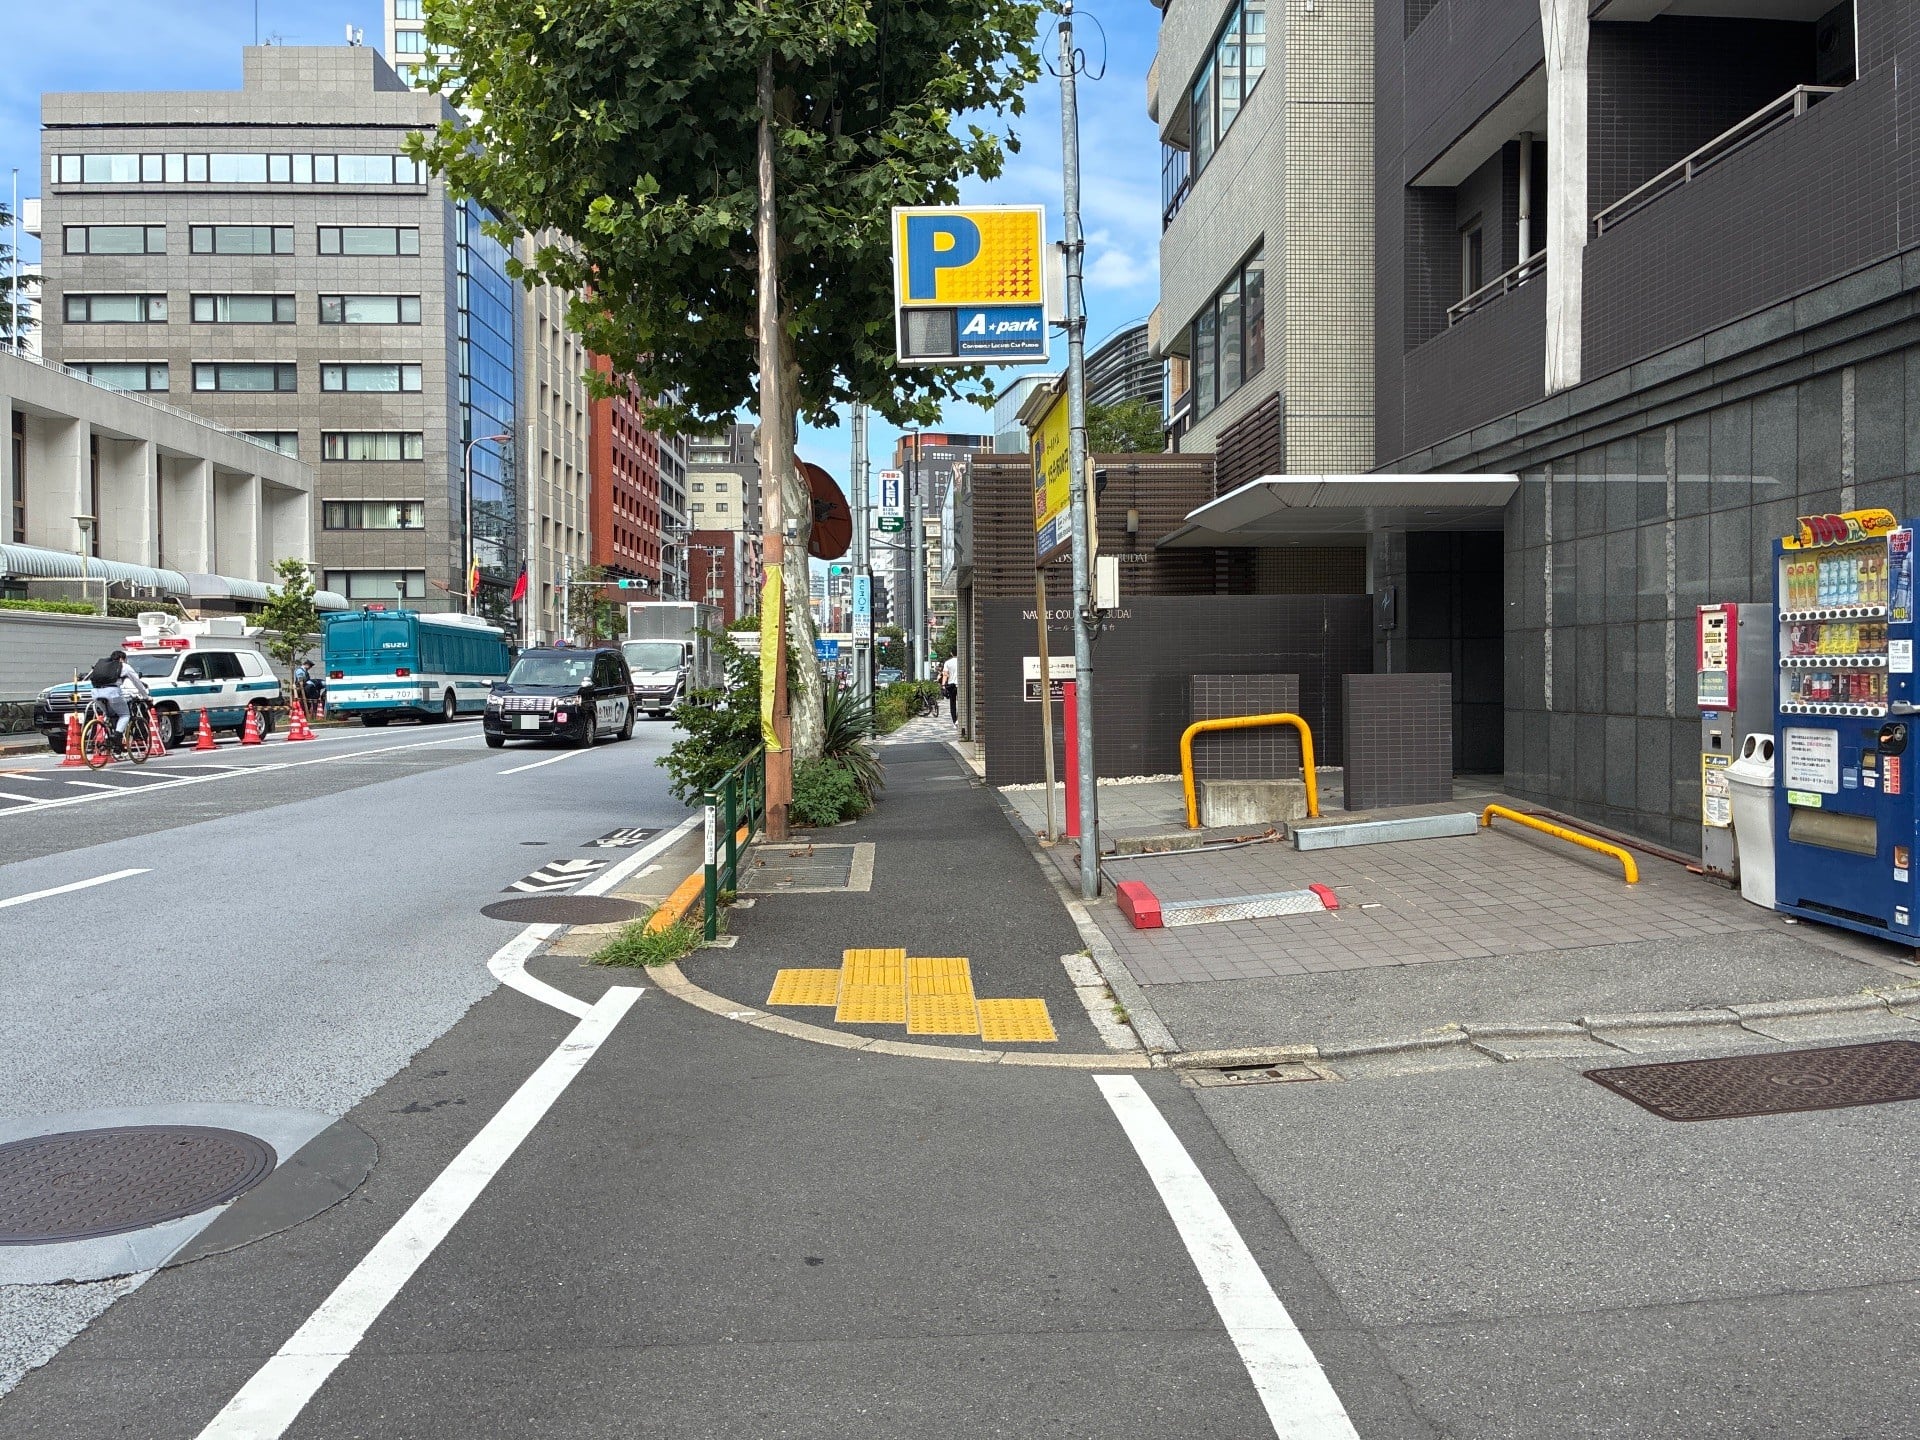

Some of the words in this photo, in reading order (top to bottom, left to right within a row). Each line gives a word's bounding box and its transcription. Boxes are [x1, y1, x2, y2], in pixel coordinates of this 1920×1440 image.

[907, 215, 981, 300] P
[995, 317, 1040, 335] park
[886, 480, 896, 507] KEN
[382, 641, 408, 649] ISUZU
